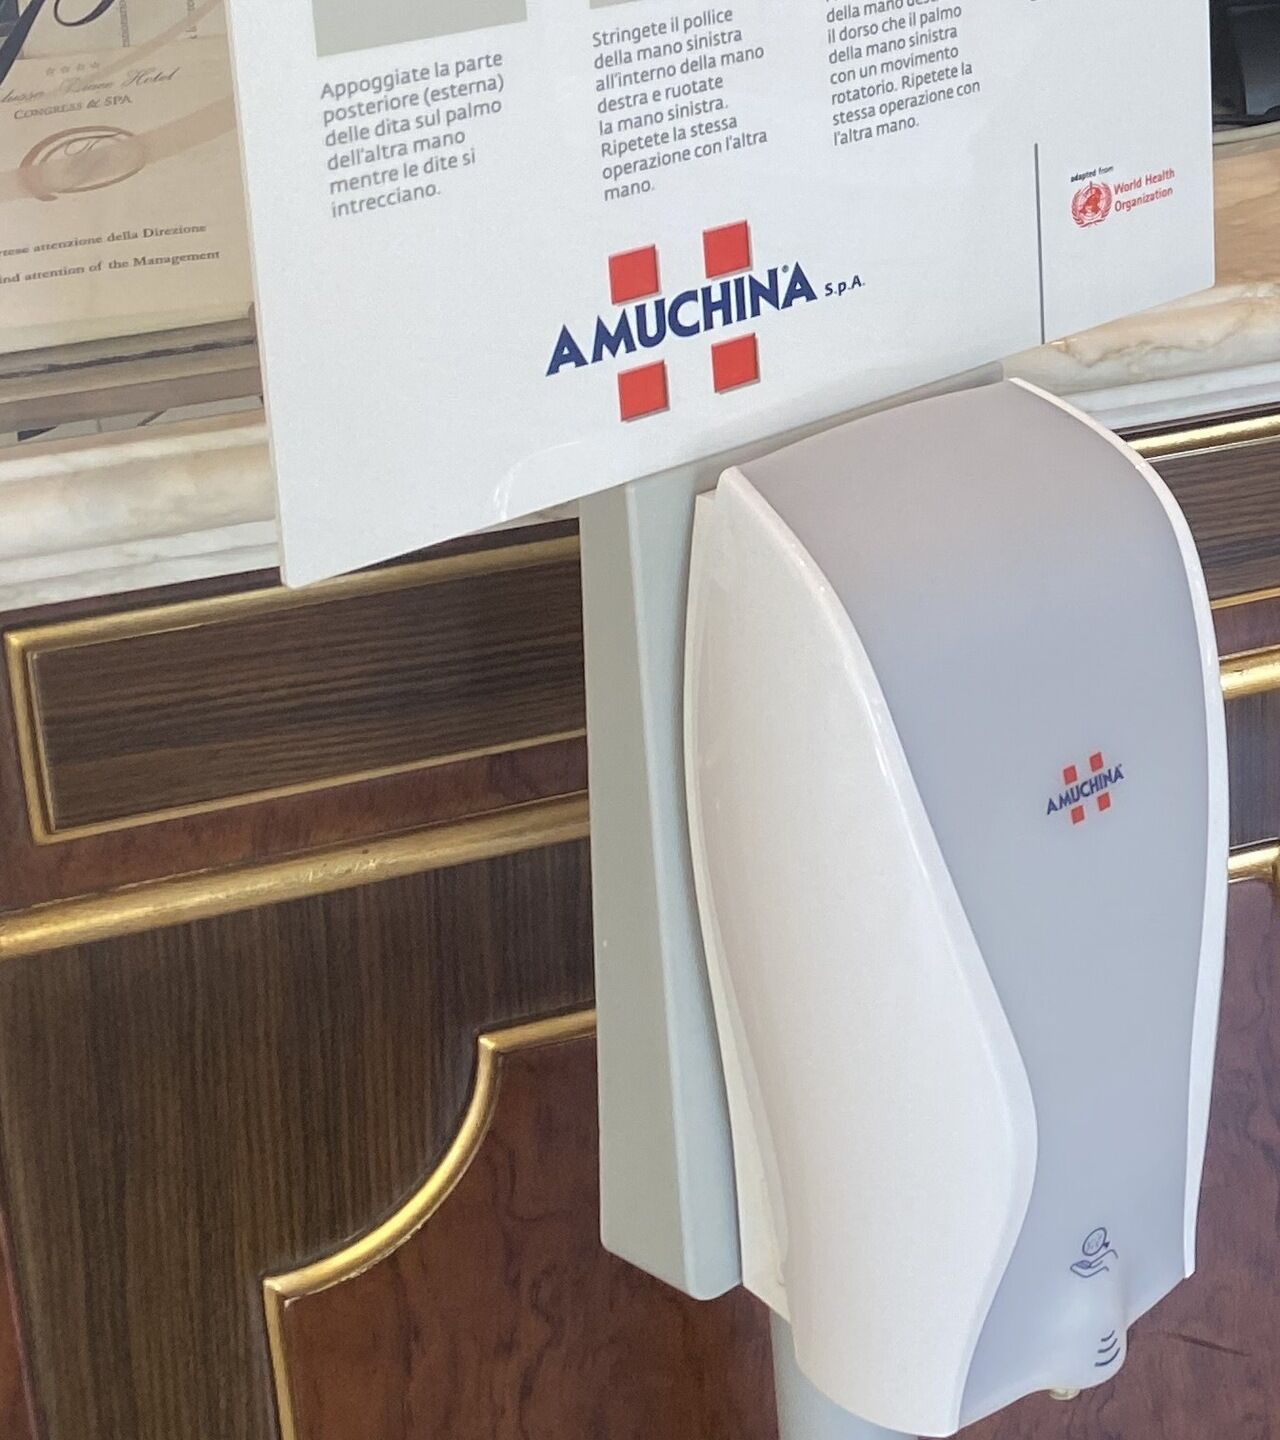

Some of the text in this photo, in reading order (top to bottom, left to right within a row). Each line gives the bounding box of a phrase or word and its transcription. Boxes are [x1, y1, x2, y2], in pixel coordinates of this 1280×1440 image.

[592, 9, 733, 48] Stringete il pollice
[594, 29, 743, 69] della mano sinistra
[320, 53, 503, 100] Appoggiate la parte
[596, 46, 764, 92] all'interno della mano
[104, 95, 131, 106] SPA
[324, 74, 504, 127] posteriore (esterna)
[597, 76, 724, 113] destra e ruotate
[325, 100, 502, 147] delle dita sul palmo
[600, 97, 728, 136] la mano sinistra.
[327, 131, 465, 170] dell'altra mano
[601, 116, 738, 157] Ripetete la stessa
[602, 131, 768, 181] operazione con l'altra
[330, 148, 476, 195] mentre le dite si
[604, 180, 655, 201] mano.
[1071, 166, 1114, 182] adapted from
[1114, 168, 1175, 195] World Health
[331, 183, 441, 218] intrecciano.
[1115, 187, 1173, 212] Organization
[33, 235, 103, 252] attenzione
[107, 231, 138, 242] della
[143, 224, 206, 238] Direzione
[25, 265, 84, 281] attention
[89, 261, 102, 272] of
[109, 259, 129, 270] the
[134, 250, 220, 267] Management
[545, 261, 818, 377] AMUCHINA
[1047, 765, 1124, 815] AMUCHINA
